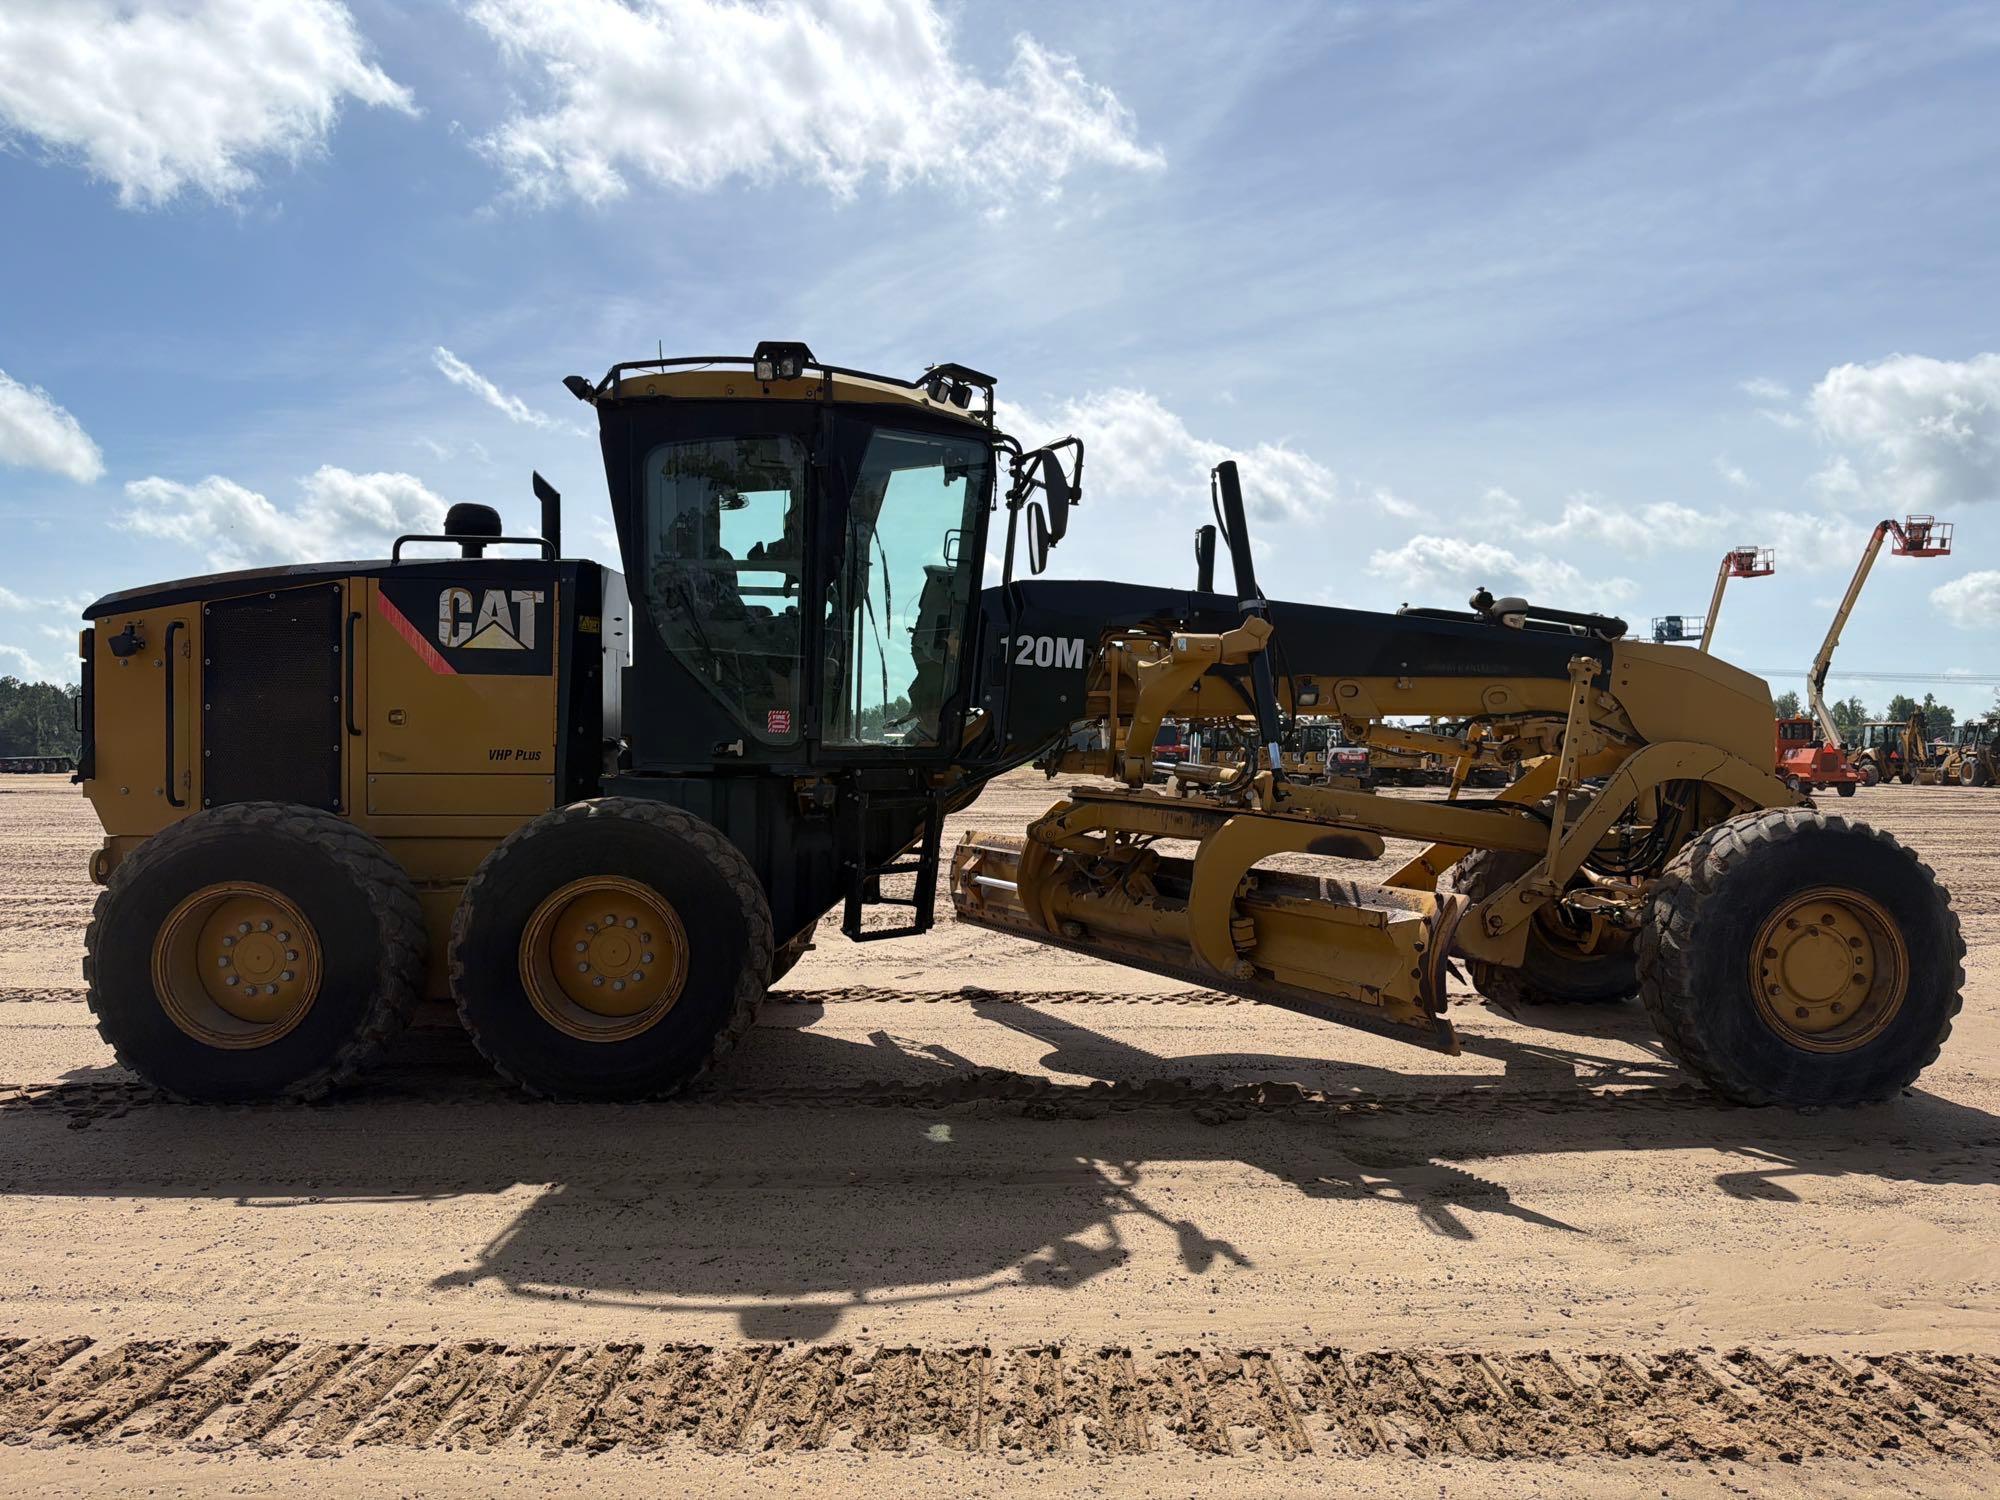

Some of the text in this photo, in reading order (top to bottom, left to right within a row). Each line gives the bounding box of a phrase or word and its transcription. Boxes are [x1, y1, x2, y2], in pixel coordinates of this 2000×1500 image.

[438, 586, 545, 650] CAT
[1000, 634, 1085, 670] 120M
[489, 749, 513, 761] VHP
